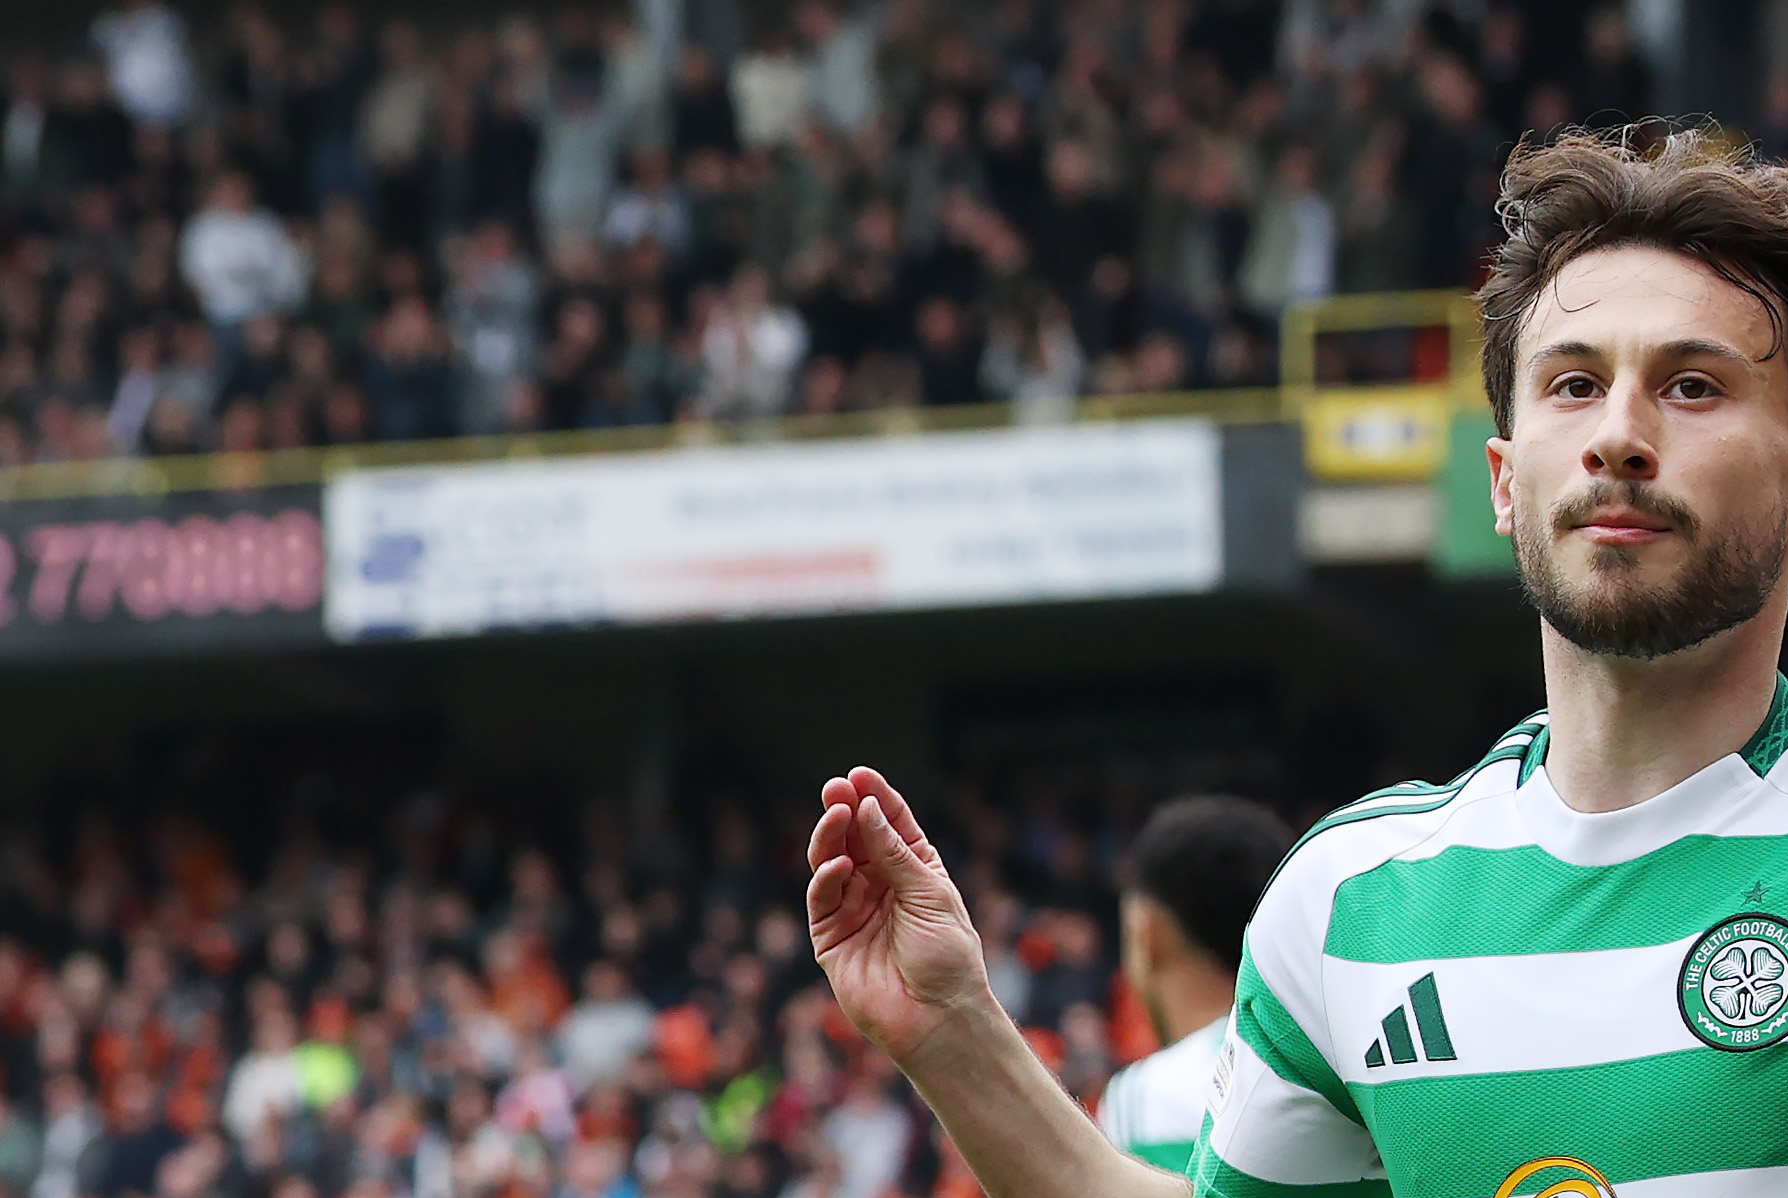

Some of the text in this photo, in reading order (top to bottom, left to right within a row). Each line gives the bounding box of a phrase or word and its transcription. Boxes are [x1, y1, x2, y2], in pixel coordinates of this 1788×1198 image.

[1686, 961, 1702, 990] THE
[1696, 927, 1732, 964] CELTIC
[1730, 1028, 1760, 1043] 1888
